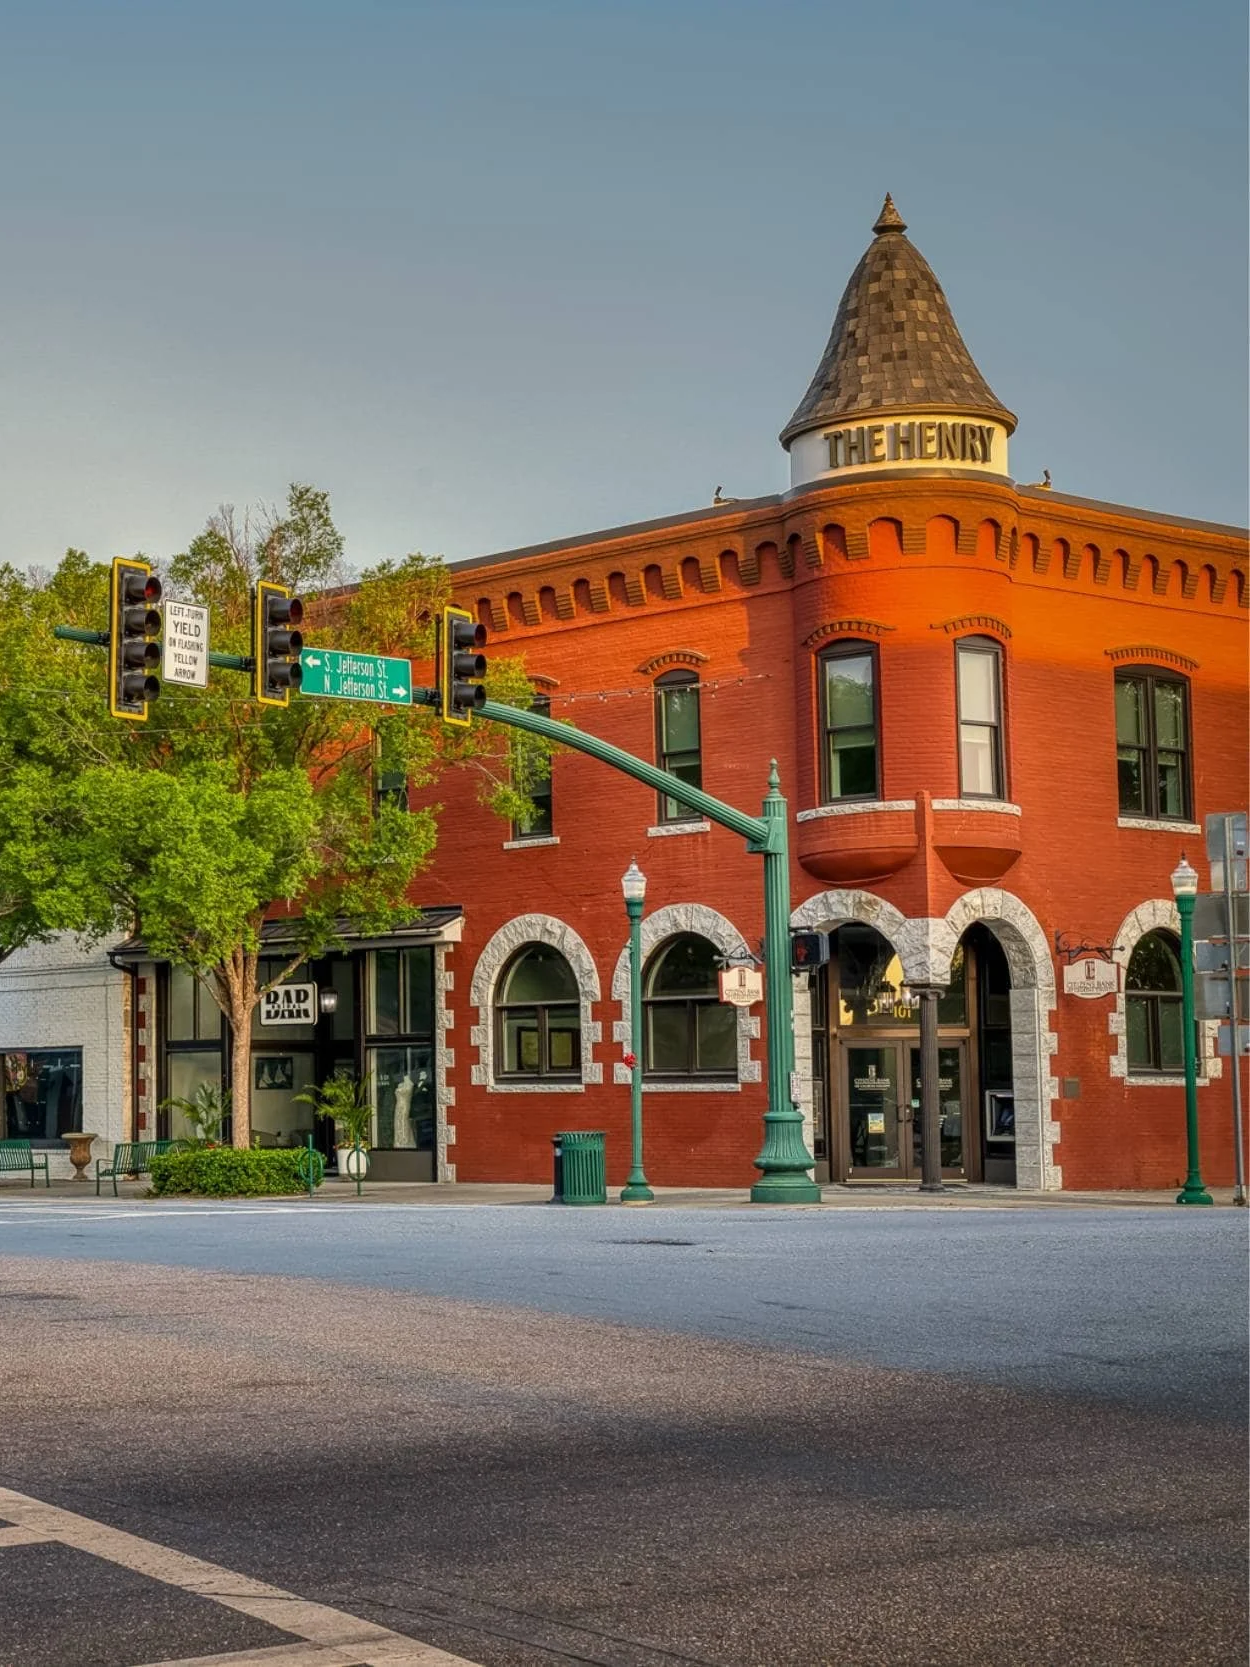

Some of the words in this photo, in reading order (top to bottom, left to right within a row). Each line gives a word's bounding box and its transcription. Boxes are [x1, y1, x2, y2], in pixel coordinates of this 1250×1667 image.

[824, 424, 887, 468] THE
[892, 421, 995, 464] HENRY
[170, 606, 184, 617] LEFT
[186, 608, 204, 621] TURN
[173, 620, 201, 638] YIELD
[169, 636, 177, 648] ON
[178, 638, 204, 653] FLASHING
[174, 653, 198, 666] YELLOW
[324, 653, 333, 673] S.
[336, 655, 375, 678] Jefferson
[377, 660, 389, 680] St.
[174, 667, 196, 680] ARROW
[324, 674, 334, 694] N.
[337, 676, 376, 698] Jefferson
[377, 680, 390, 699] St.
